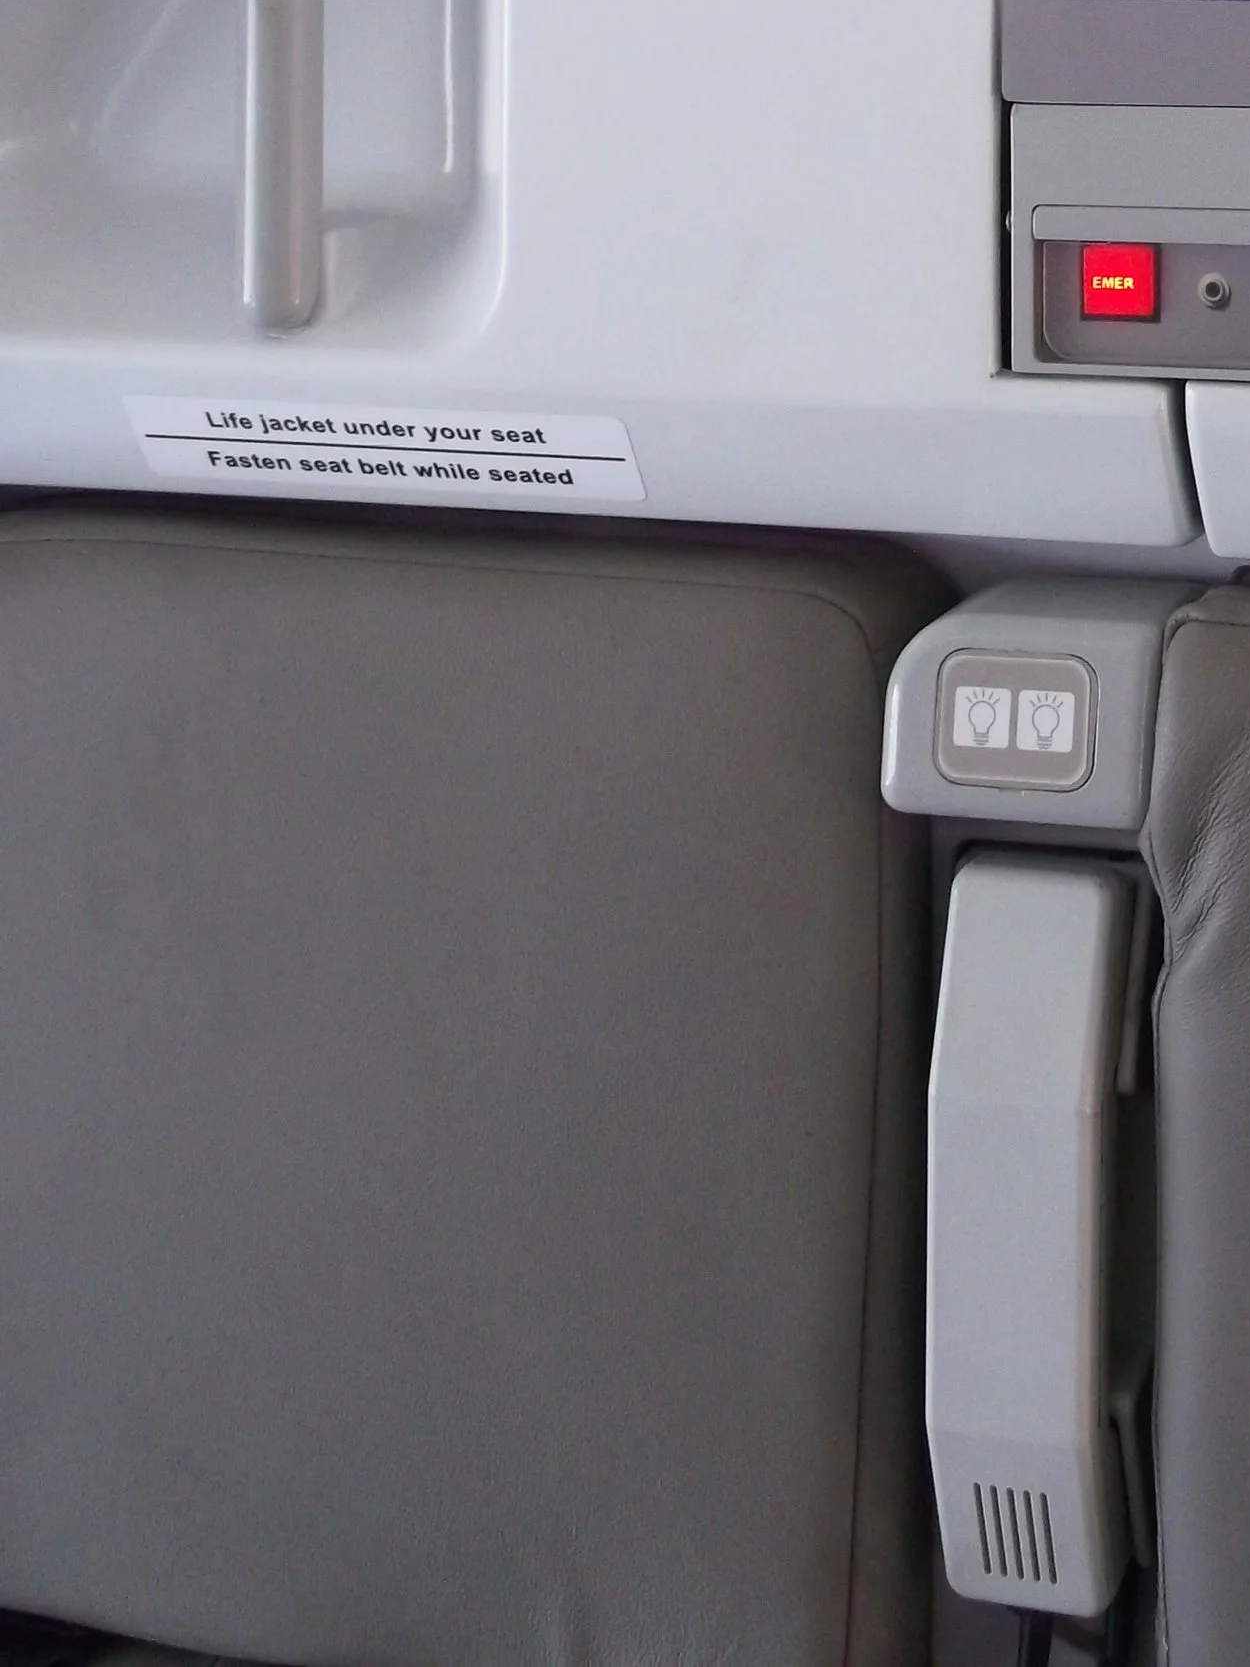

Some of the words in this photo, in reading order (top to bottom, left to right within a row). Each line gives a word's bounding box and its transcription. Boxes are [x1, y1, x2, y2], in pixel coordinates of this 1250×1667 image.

[1092, 276, 1134, 290] EMER
[205, 411, 253, 430] Life
[259, 414, 337, 435] jacket
[343, 420, 416, 438] under
[423, 426, 482, 443] your
[490, 428, 547, 444] seat
[207, 450, 292, 471] Fasten
[298, 458, 353, 474] seat
[357, 458, 408, 477] belt
[412, 462, 481, 481] while
[488, 468, 574, 485] seated
